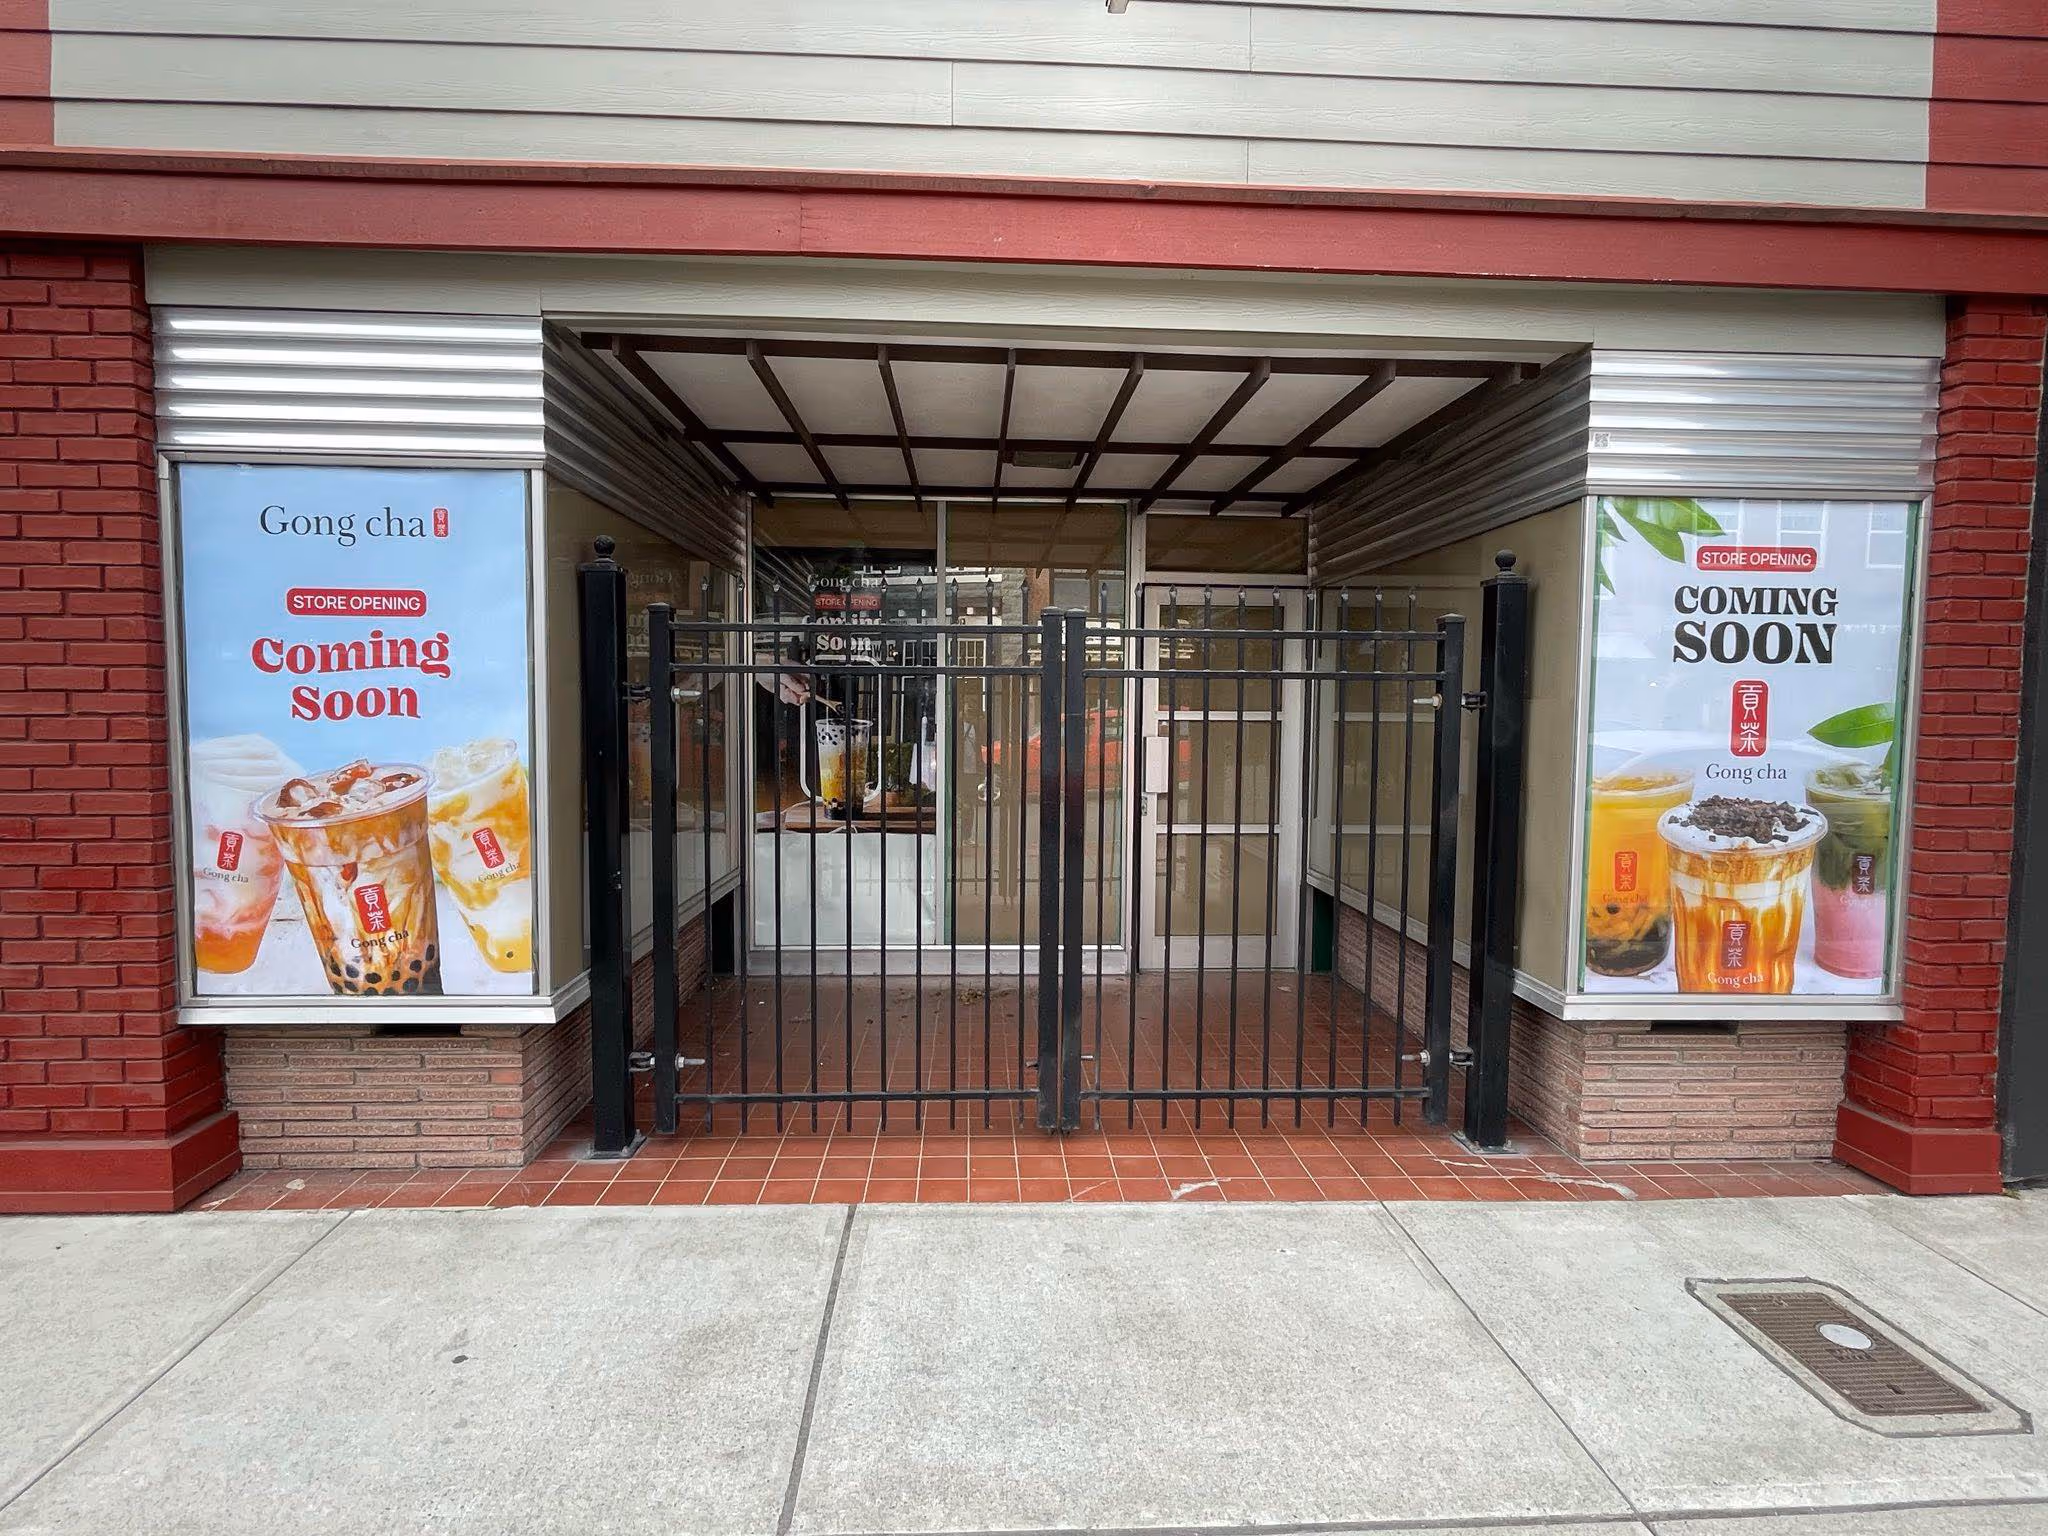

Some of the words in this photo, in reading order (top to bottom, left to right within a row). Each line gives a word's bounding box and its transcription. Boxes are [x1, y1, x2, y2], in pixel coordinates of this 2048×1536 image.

[260, 505, 356, 547] Gong
[365, 506, 427, 538] cha
[1702, 551, 1748, 565] STORE
[1750, 552, 1812, 566] OPENING
[293, 595, 347, 610] STORE
[349, 596, 421, 611] OPENING
[1674, 585, 1839, 617] COMING
[252, 629, 452, 679] Coming
[1673, 620, 1837, 665] SOON
[291, 685, 422, 722] Soon
[1738, 684, 1763, 752] 貢茶
[1706, 763, 1753, 785] Gong
[1757, 763, 1787, 780] cha
[221, 833, 241, 869] 貢茶
[476, 829, 501, 866] 貢茶
[1856, 855, 1873, 892] 貢茶
[360, 886, 386, 931] 貢茶
[351, 936, 388, 949] Gong
[388, 929, 410, 943] cha
[1727, 923, 1747, 967] 貢茶
[1707, 972, 1741, 989] Gong
[1742, 972, 1764, 984] cha
